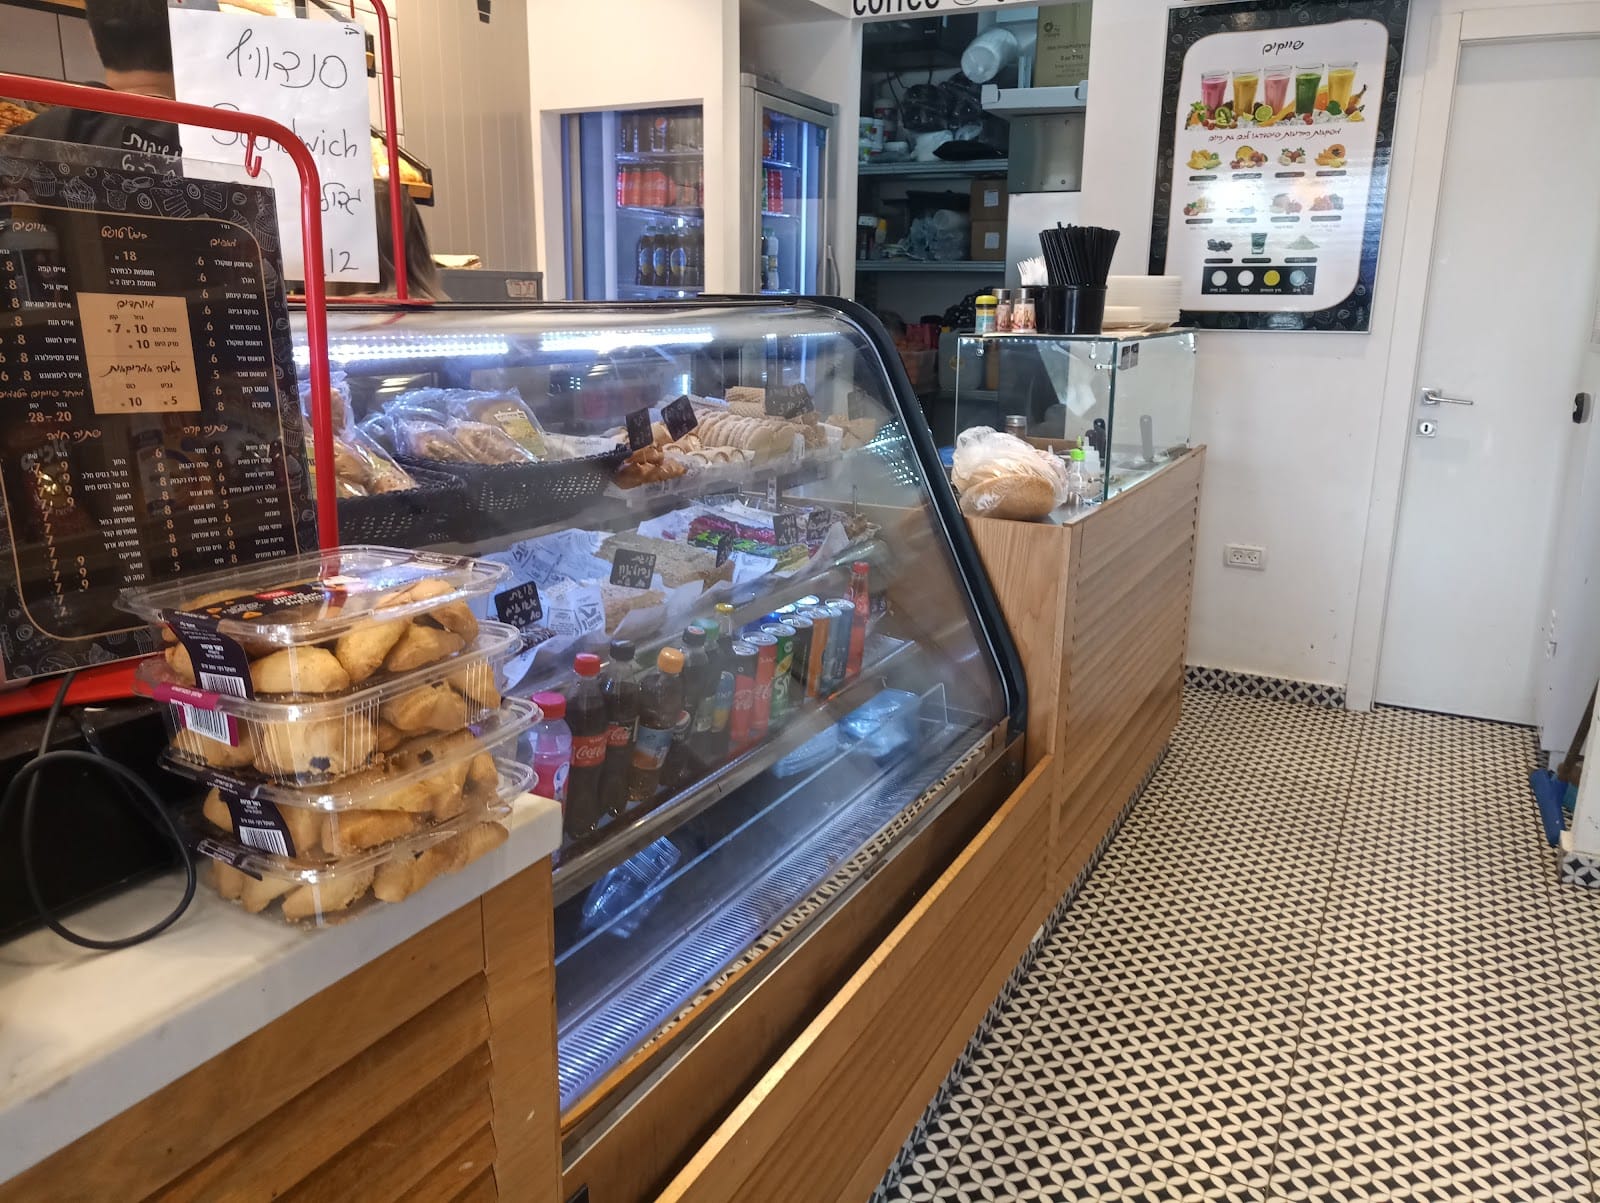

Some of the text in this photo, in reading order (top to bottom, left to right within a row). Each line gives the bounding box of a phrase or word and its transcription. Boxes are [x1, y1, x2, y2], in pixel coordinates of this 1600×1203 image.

[123, 251, 137, 261] 18
[6, 261, 15, 272] 8
[198, 256, 205, 267] 6
[200, 273, 207, 283] 6
[8, 279, 17, 290] 8
[203, 289, 209, 299] 6
[11, 298, 20, 309] 8
[205, 305, 211, 315] 6
[15, 316, 23, 327] 8
[207, 321, 214, 331] 6
[115, 324, 148, 334] 10 7
[18, 334, 26, 345] 8
[136, 340, 150, 349] 10
[209, 338, 216, 347] 6
[20, 352, 29, 363] 8
[211, 354, 218, 364] 6
[1, 371, 9, 381] 6
[24, 370, 32, 381] 8
[213, 370, 220, 380] 5
[215, 386, 223, 396] 6
[128, 396, 178, 407] 5 10
[217, 402, 225, 411] 8
[155, 448, 162, 458] 6
[214, 445, 221, 455] 6
[61, 461, 69, 471] 9
[158, 462, 165, 473] 8
[217, 459, 223, 468] 6
[63, 473, 71, 483] 9
[160, 476, 167, 487] 8
[218, 473, 225, 482] 6
[65, 485, 73, 495] 9
[221, 486, 227, 496] 6
[162, 491, 169, 501] 8
[66, 497, 75, 507] 9
[223, 500, 229, 510] 5
[164, 505, 172, 515] 8
[42, 511, 49, 522] 7
[225, 513, 232, 523] 6
[44, 523, 52, 534] 7
[166, 520, 174, 529] 8
[227, 527, 234, 537] 6
[47, 536, 54, 546] 7
[169, 533, 177, 543] 8
[229, 541, 236, 550] 8
[48, 547, 56, 558] 7
[171, 547, 179, 558] 8
[51, 559, 58, 570] 7
[77, 556, 85, 566] 9
[174, 562, 181, 572] 5
[53, 567, 88, 581] 9 7
[55, 583, 62, 594] 7
[81, 580, 89, 590] 9
